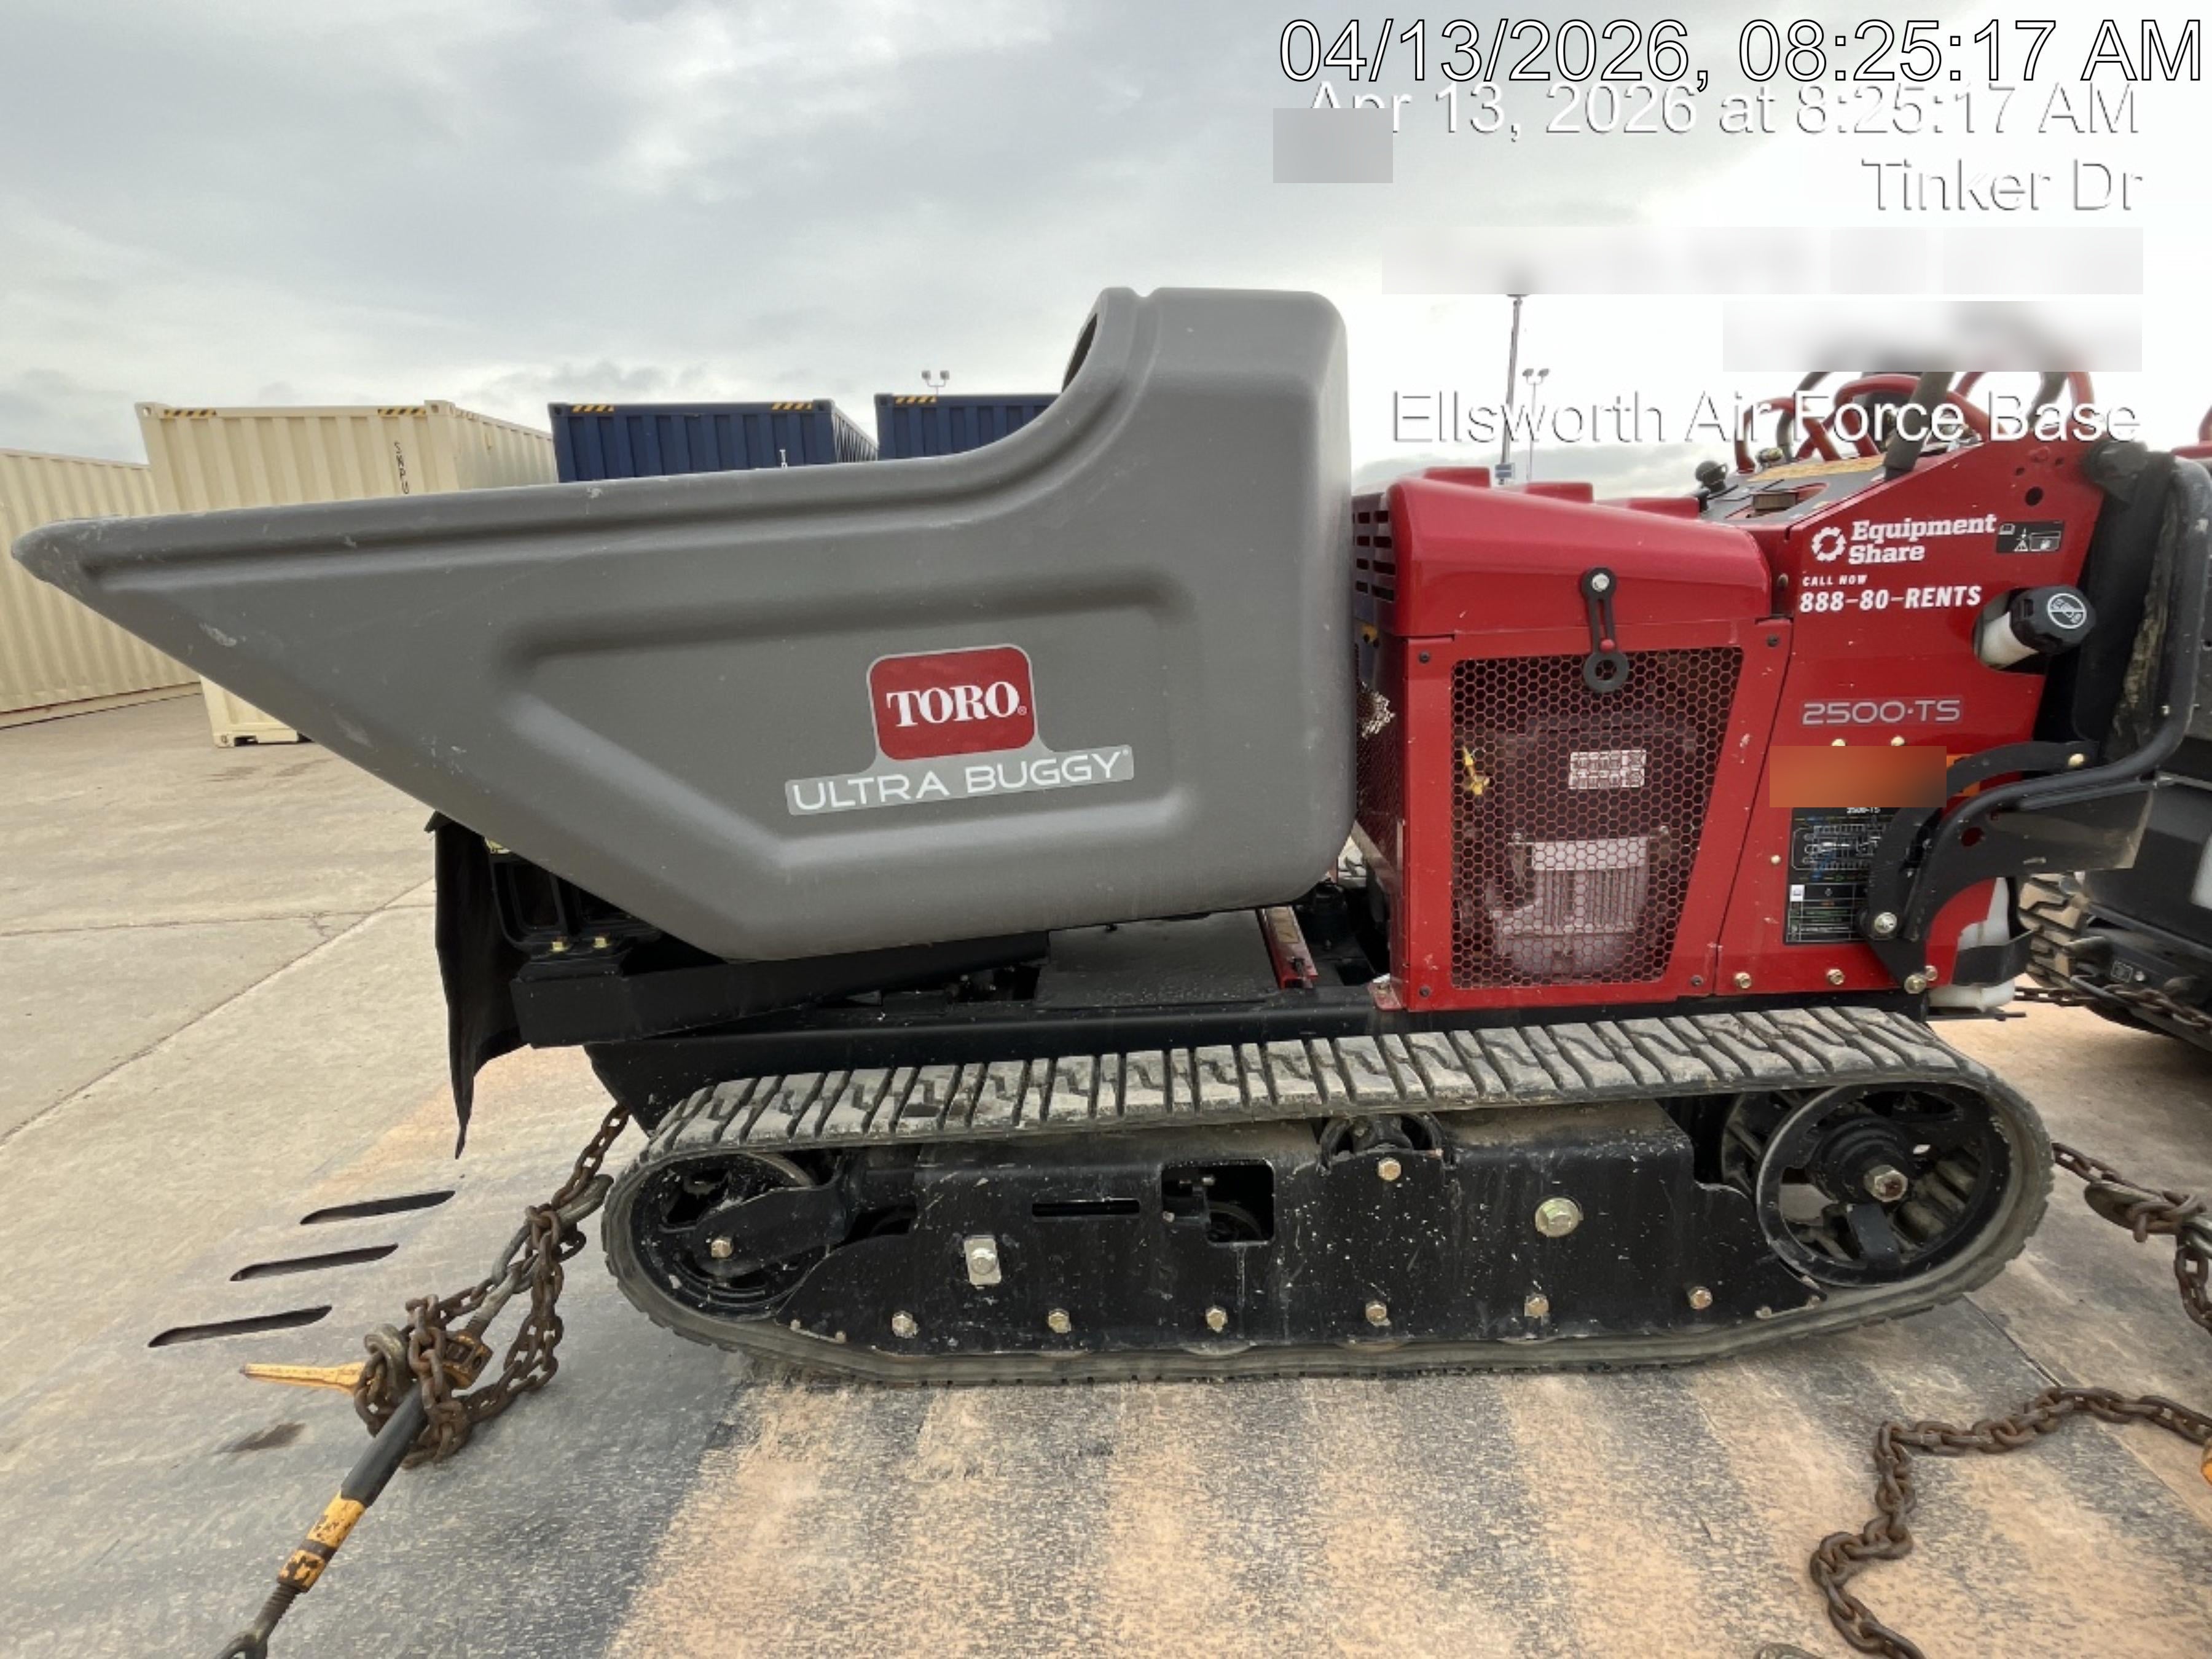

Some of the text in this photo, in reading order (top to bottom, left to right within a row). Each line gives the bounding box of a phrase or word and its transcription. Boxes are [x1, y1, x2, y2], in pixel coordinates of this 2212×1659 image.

[1851, 514, 1998, 543] Equipment
[1848, 543, 1925, 565] Share
[1802, 574, 1868, 587] CALL NOW
[1800, 586, 1983, 613] 888-80-RENTS
[792, 771, 950, 810] ULTRA
